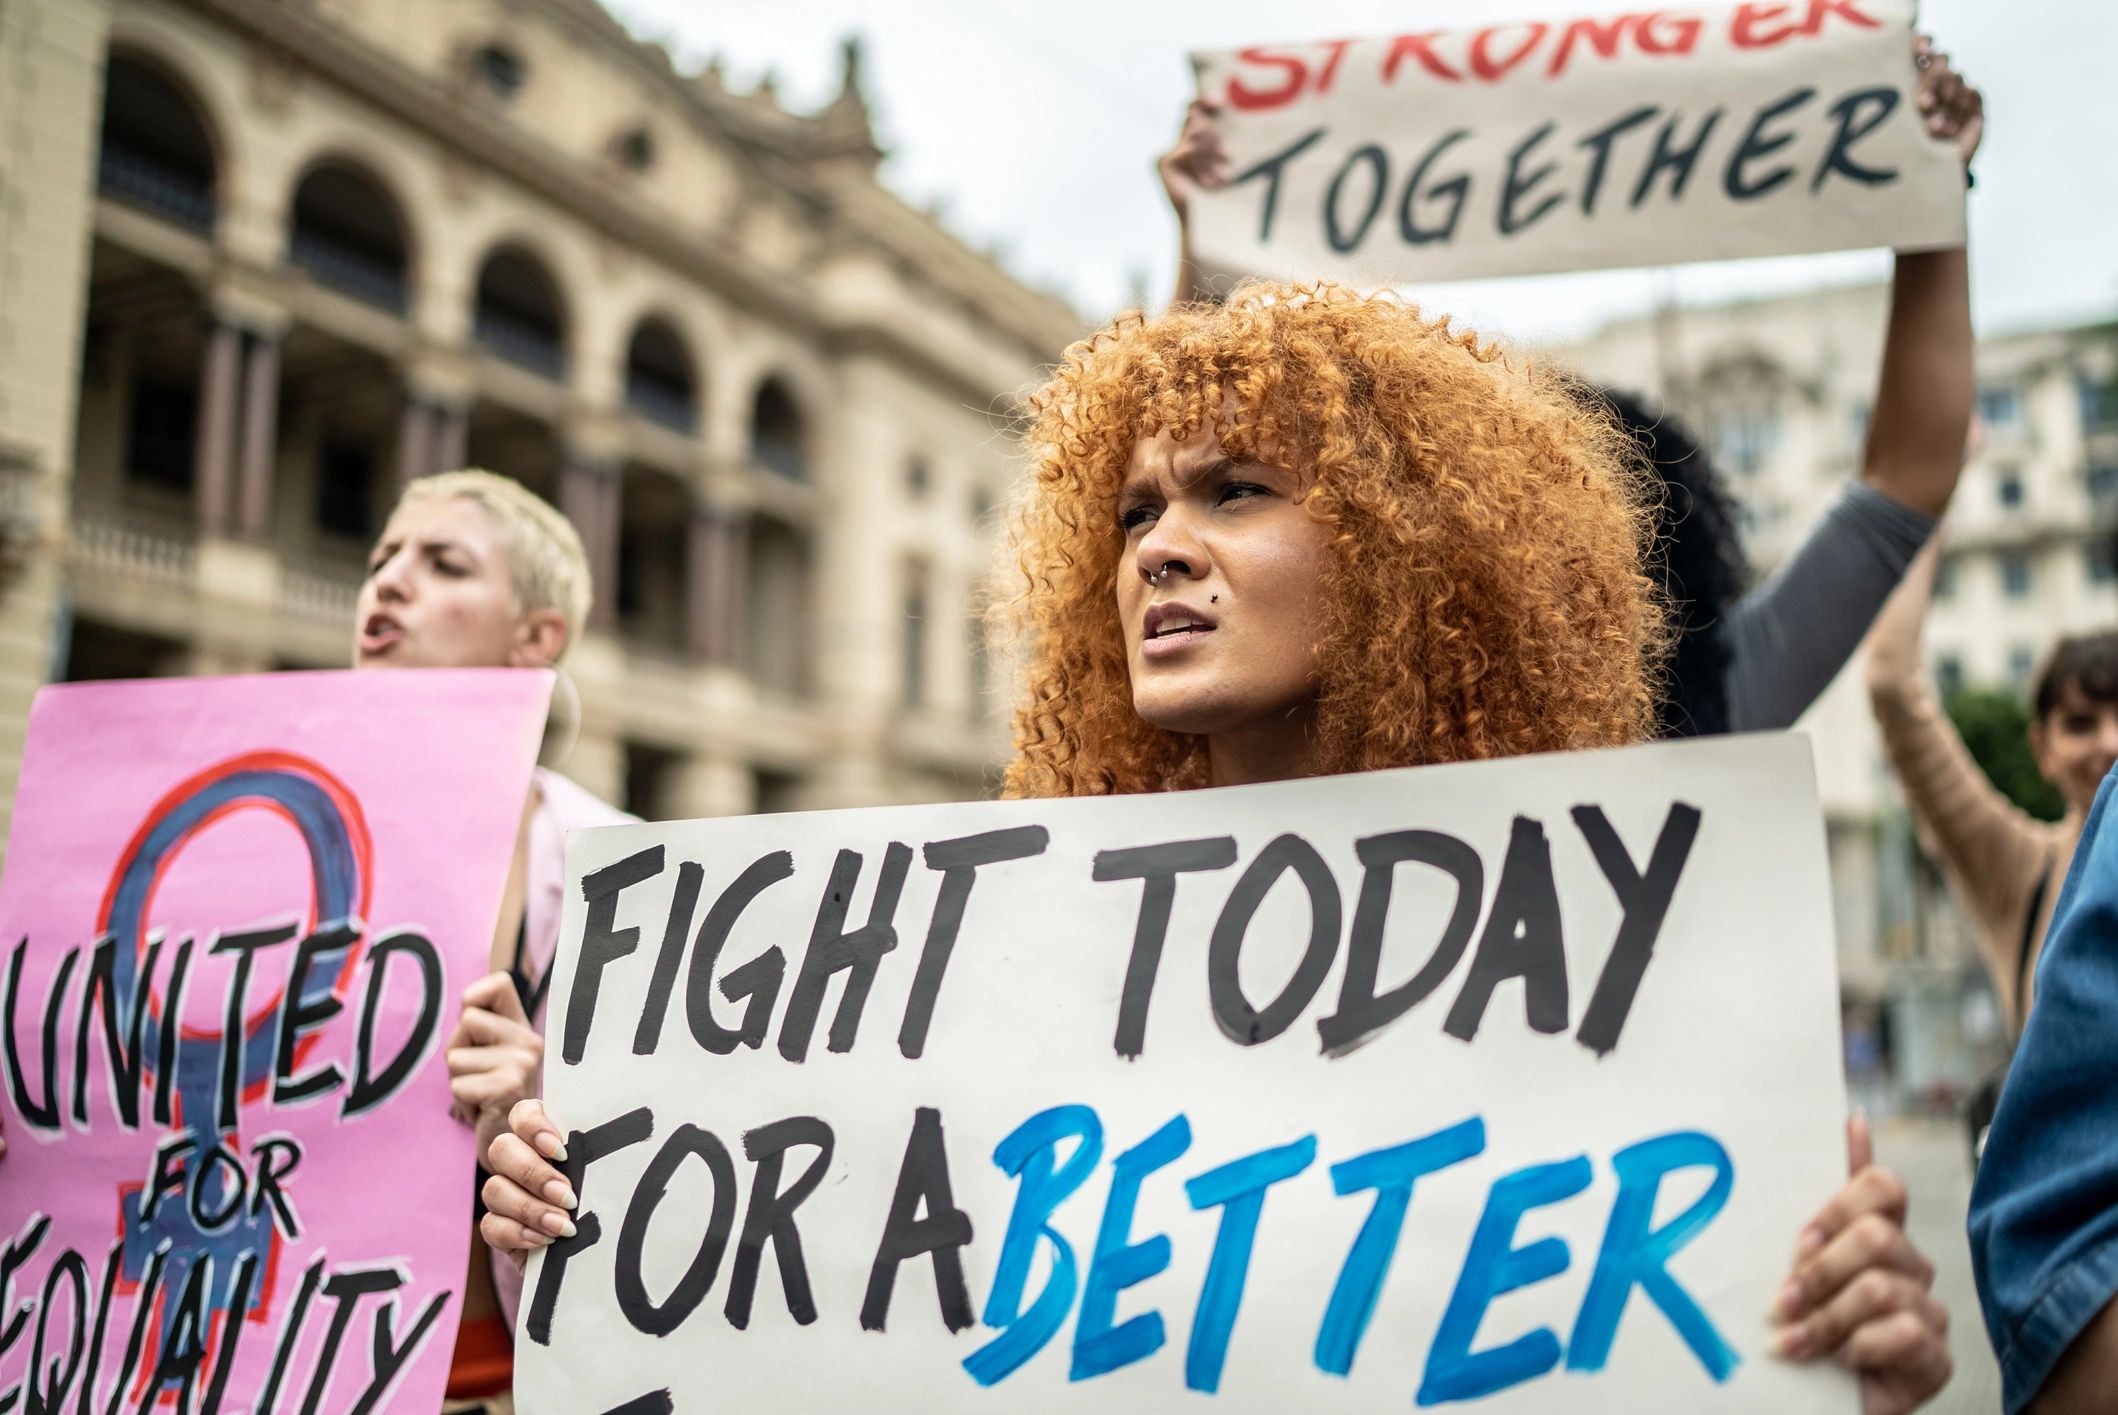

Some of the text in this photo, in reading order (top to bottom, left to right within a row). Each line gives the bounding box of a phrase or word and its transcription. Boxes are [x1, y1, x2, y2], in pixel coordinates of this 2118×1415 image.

[1231, 85, 1901, 254] TOGETHER
[2, 922, 444, 1131] UNITED
[562, 801, 1702, 1066] FIGHT TODAY
[138, 1136, 302, 1240] FOR
[526, 1104, 1744, 1408] FOR A BETTER
